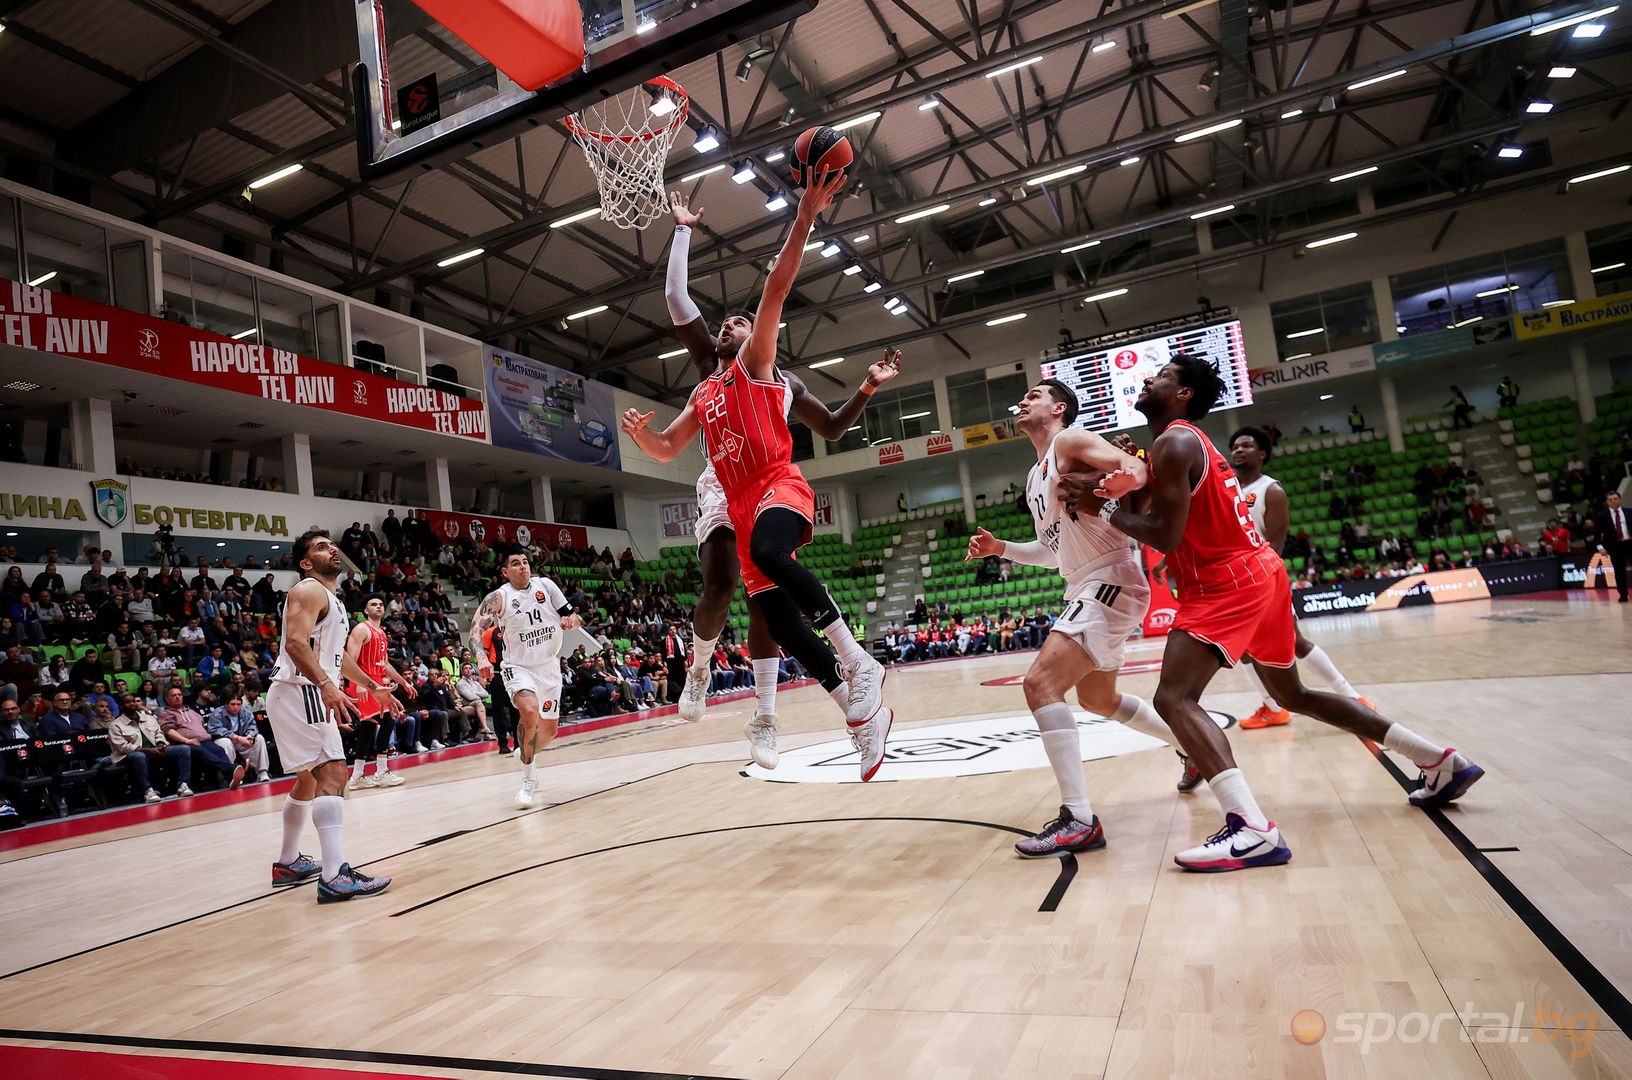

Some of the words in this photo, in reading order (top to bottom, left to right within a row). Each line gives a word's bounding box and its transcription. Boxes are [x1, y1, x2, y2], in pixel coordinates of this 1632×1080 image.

[12, 280, 53, 314] IBI
[45, 317, 109, 354] AVIV
[190, 341, 270, 374] HAPOEL
[272, 348, 299, 375] IBI
[258, 375, 292, 404] TEL
[295, 376, 335, 404] AVIV
[387, 388, 441, 413] HAPOEL
[1123, 386, 1136, 396] 68
[432, 412, 456, 434] TEL
[457, 410, 487, 434] AVIV
[705, 393, 727, 424] 22
[134, 504, 288, 537] БОТЕВГРАД
[1303, 600, 1332, 613] abu
[1333, 592, 1376, 609] dhabi
[526, 609, 542, 625] 14
[519, 625, 556, 642] Emirates
